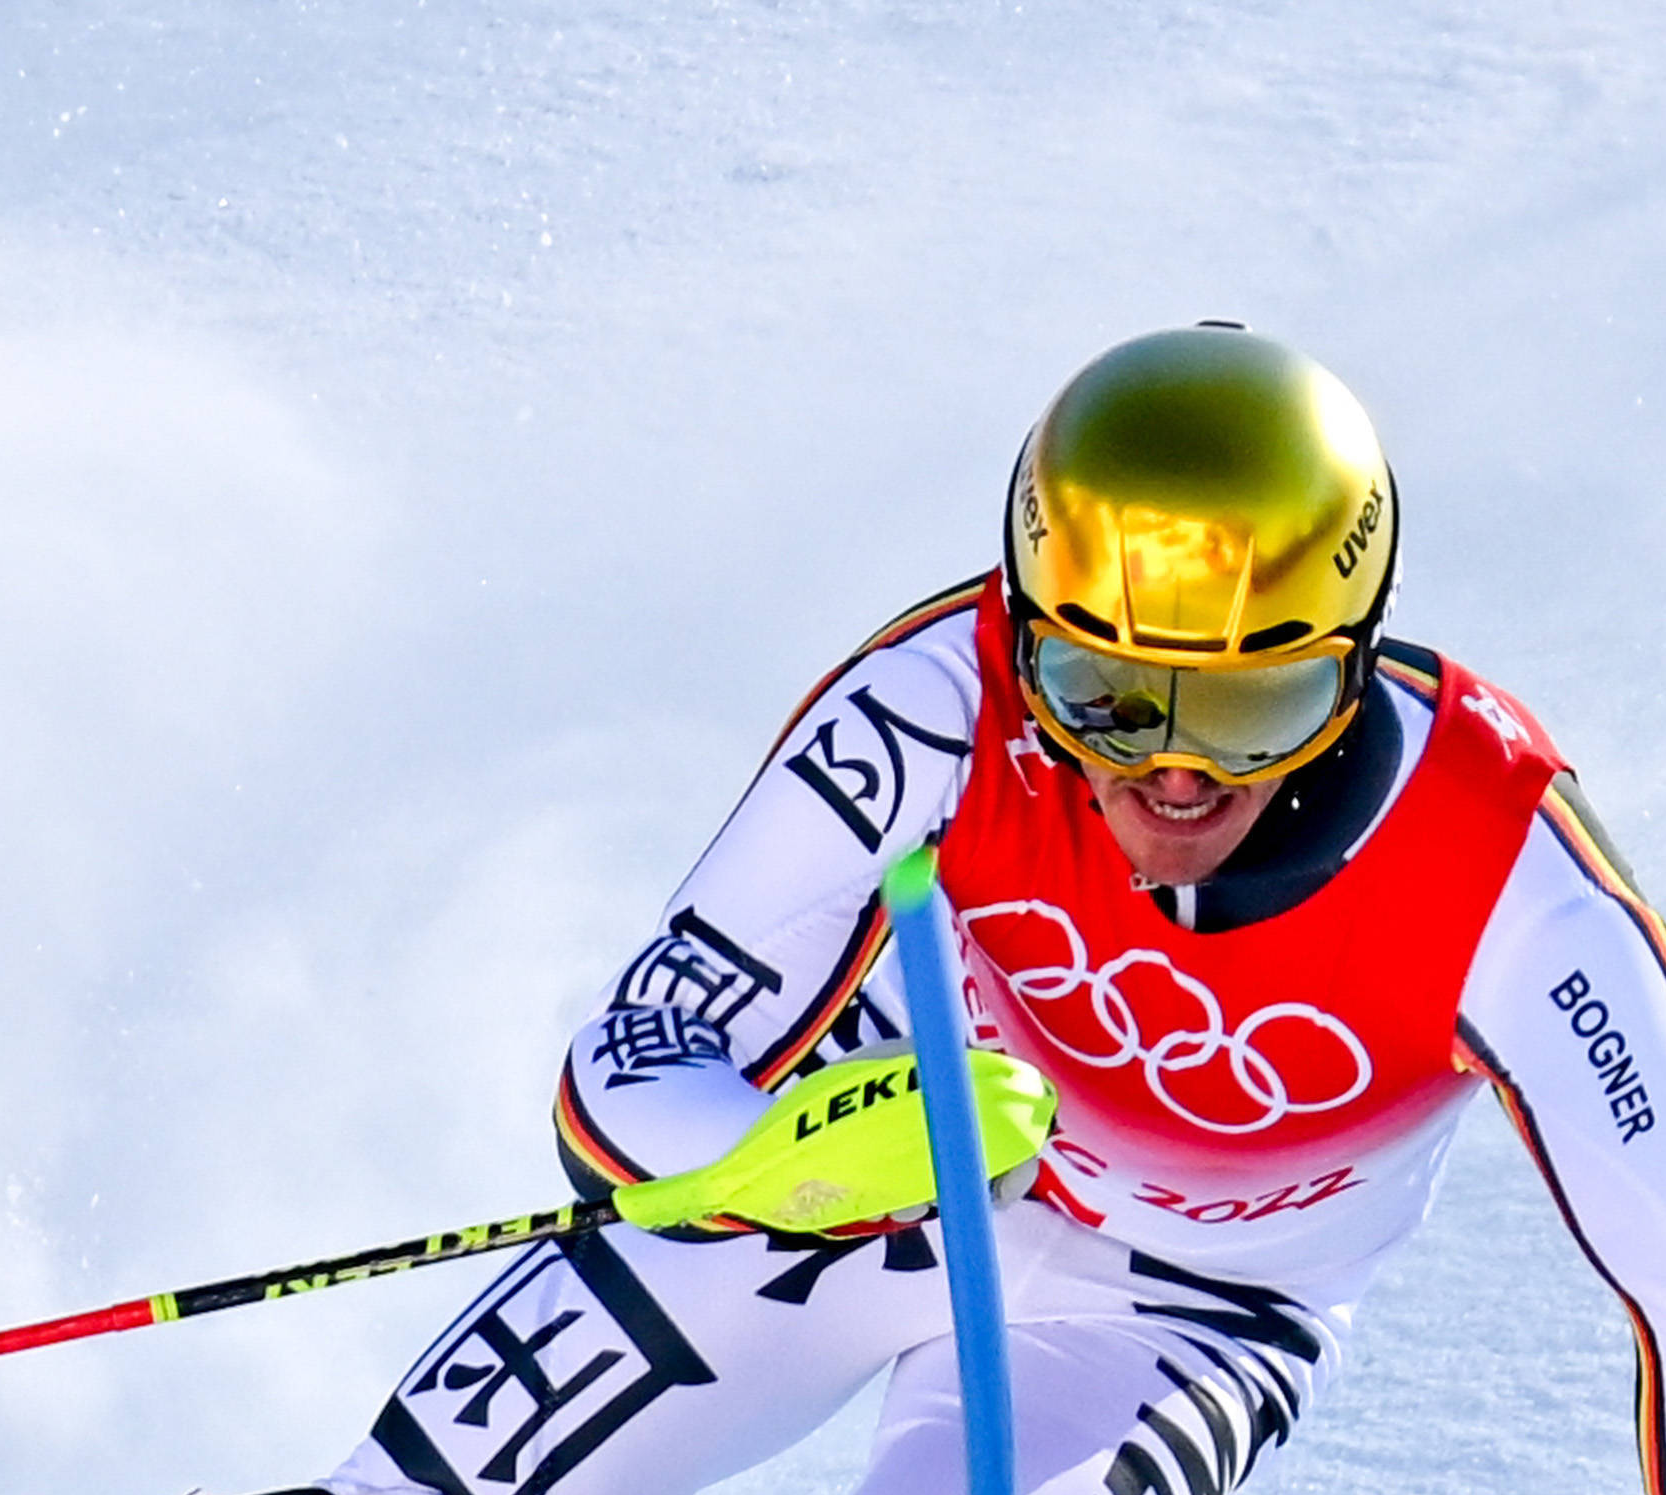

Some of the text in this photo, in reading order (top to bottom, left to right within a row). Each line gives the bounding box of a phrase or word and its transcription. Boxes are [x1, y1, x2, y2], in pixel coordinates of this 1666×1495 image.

[1332, 479, 1383, 579] uvex
[1548, 967, 1656, 1146] BOGNER
[794, 1065, 922, 1142] LEKI
[1131, 1164, 1370, 1225] 2022
